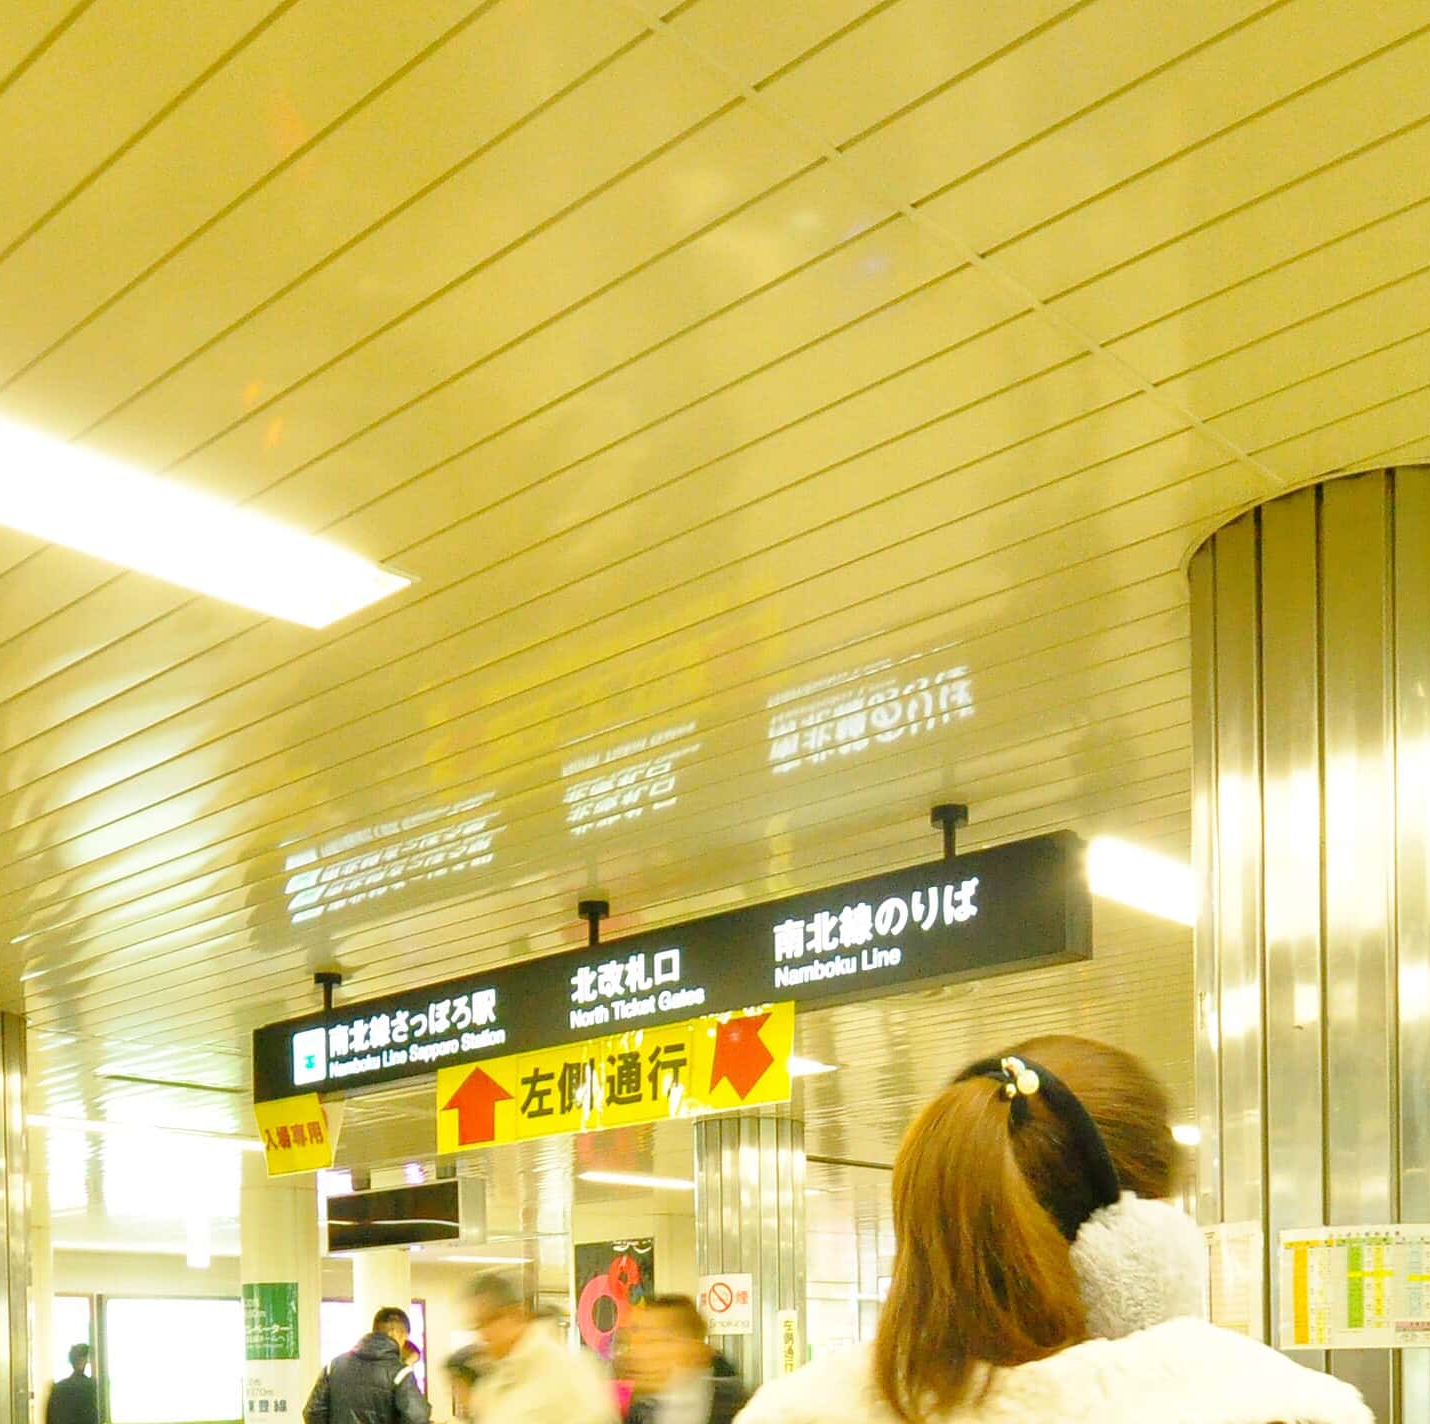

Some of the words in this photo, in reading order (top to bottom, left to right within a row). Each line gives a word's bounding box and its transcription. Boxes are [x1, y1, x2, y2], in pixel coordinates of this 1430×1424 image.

[773, 877, 979, 962] 南北線のりば
[571, 949, 680, 1004] 北改札口
[774, 955, 857, 988] Namboku
[861, 946, 902, 972] Line
[329, 988, 497, 1058] 南北線さっぽろ駅
[570, 1004, 609, 1029] North
[611, 993, 656, 1020] Ticket
[658, 987, 706, 1012] Gates
[383, 1048, 407, 1066] Line
[409, 1038, 459, 1064] Sapporo
[461, 1028, 506, 1046] Station
[520, 1042, 688, 1119] 左側通行
[264, 1120, 324, 1151] 入場専用
